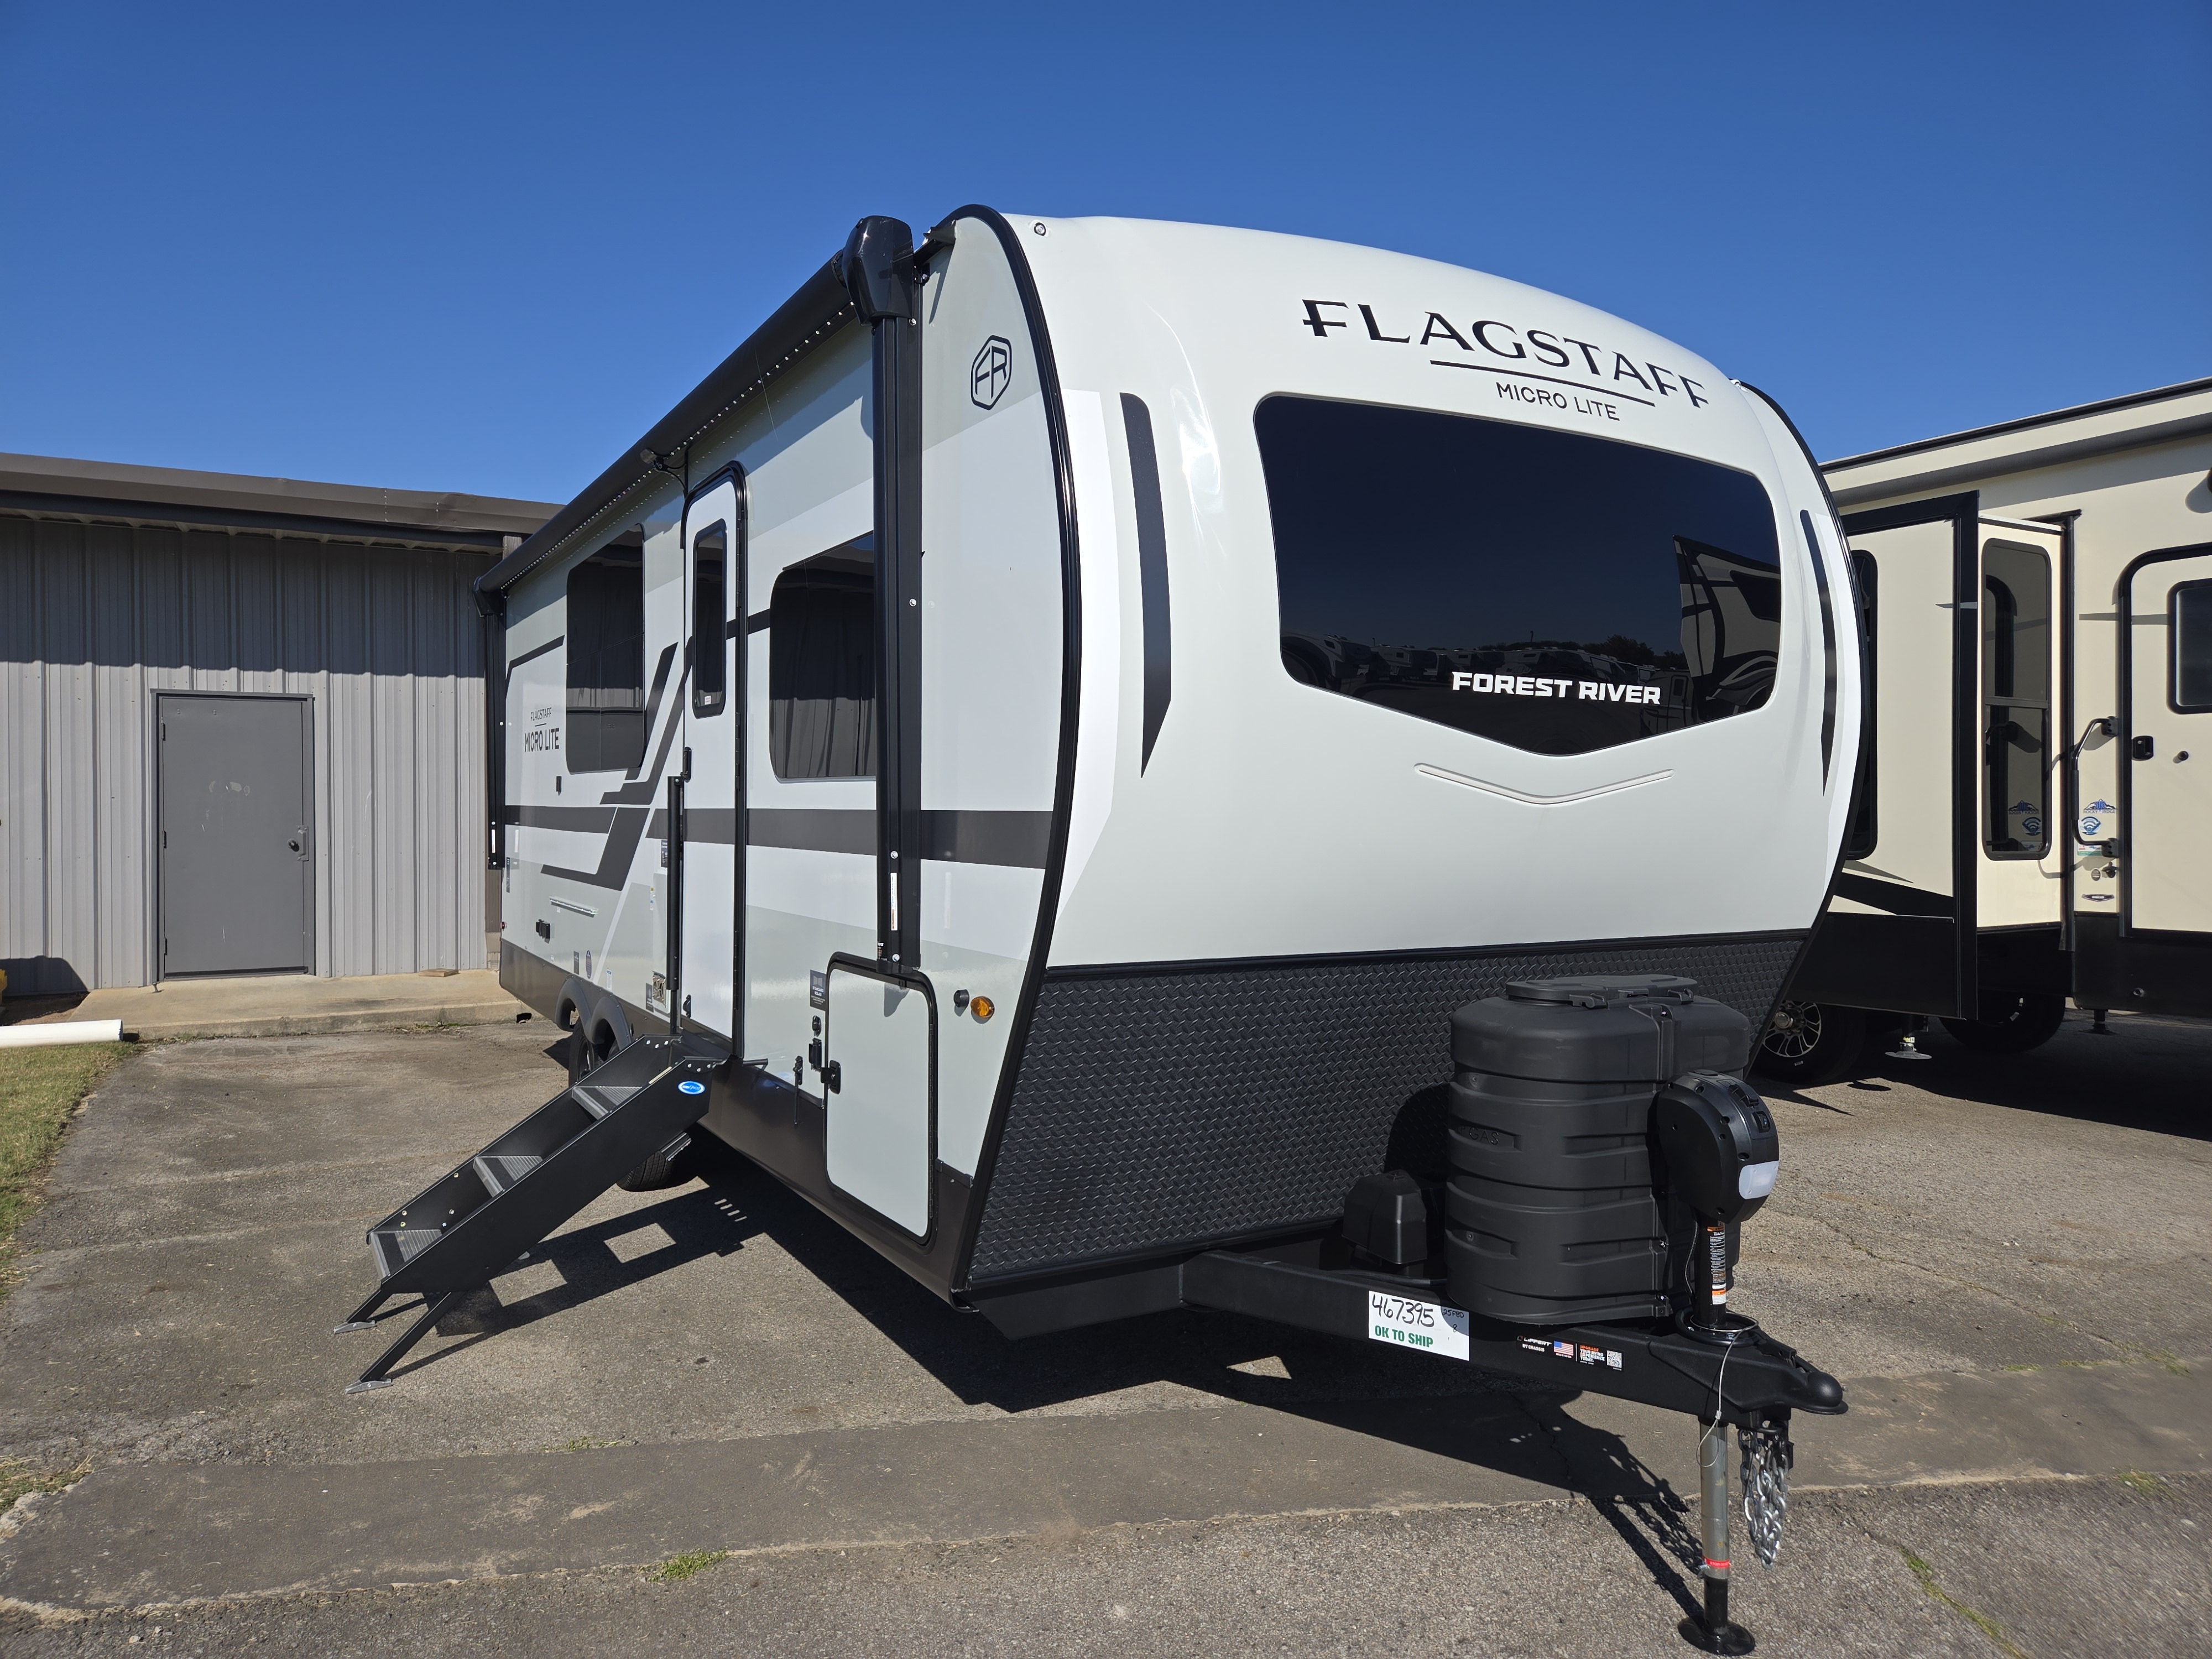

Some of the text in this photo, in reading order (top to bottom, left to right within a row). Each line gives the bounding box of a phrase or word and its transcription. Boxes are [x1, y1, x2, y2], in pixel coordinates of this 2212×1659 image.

[1302, 299, 1709, 409] FLAGSTAFF
[1496, 382, 1620, 421] MICRO LITE
[1452, 671, 1661, 705] FOREST RIVER
[531, 707, 551, 721] FLAGSTAFF
[525, 728, 559, 752] MICRO LITE
[1469, 1126, 1499, 1145] GAS
[1371, 1293, 1434, 1327] 467395
[1375, 1325, 1433, 1348] OK TO SHIP
[1524, 1337, 1552, 1346] LIPPERT
